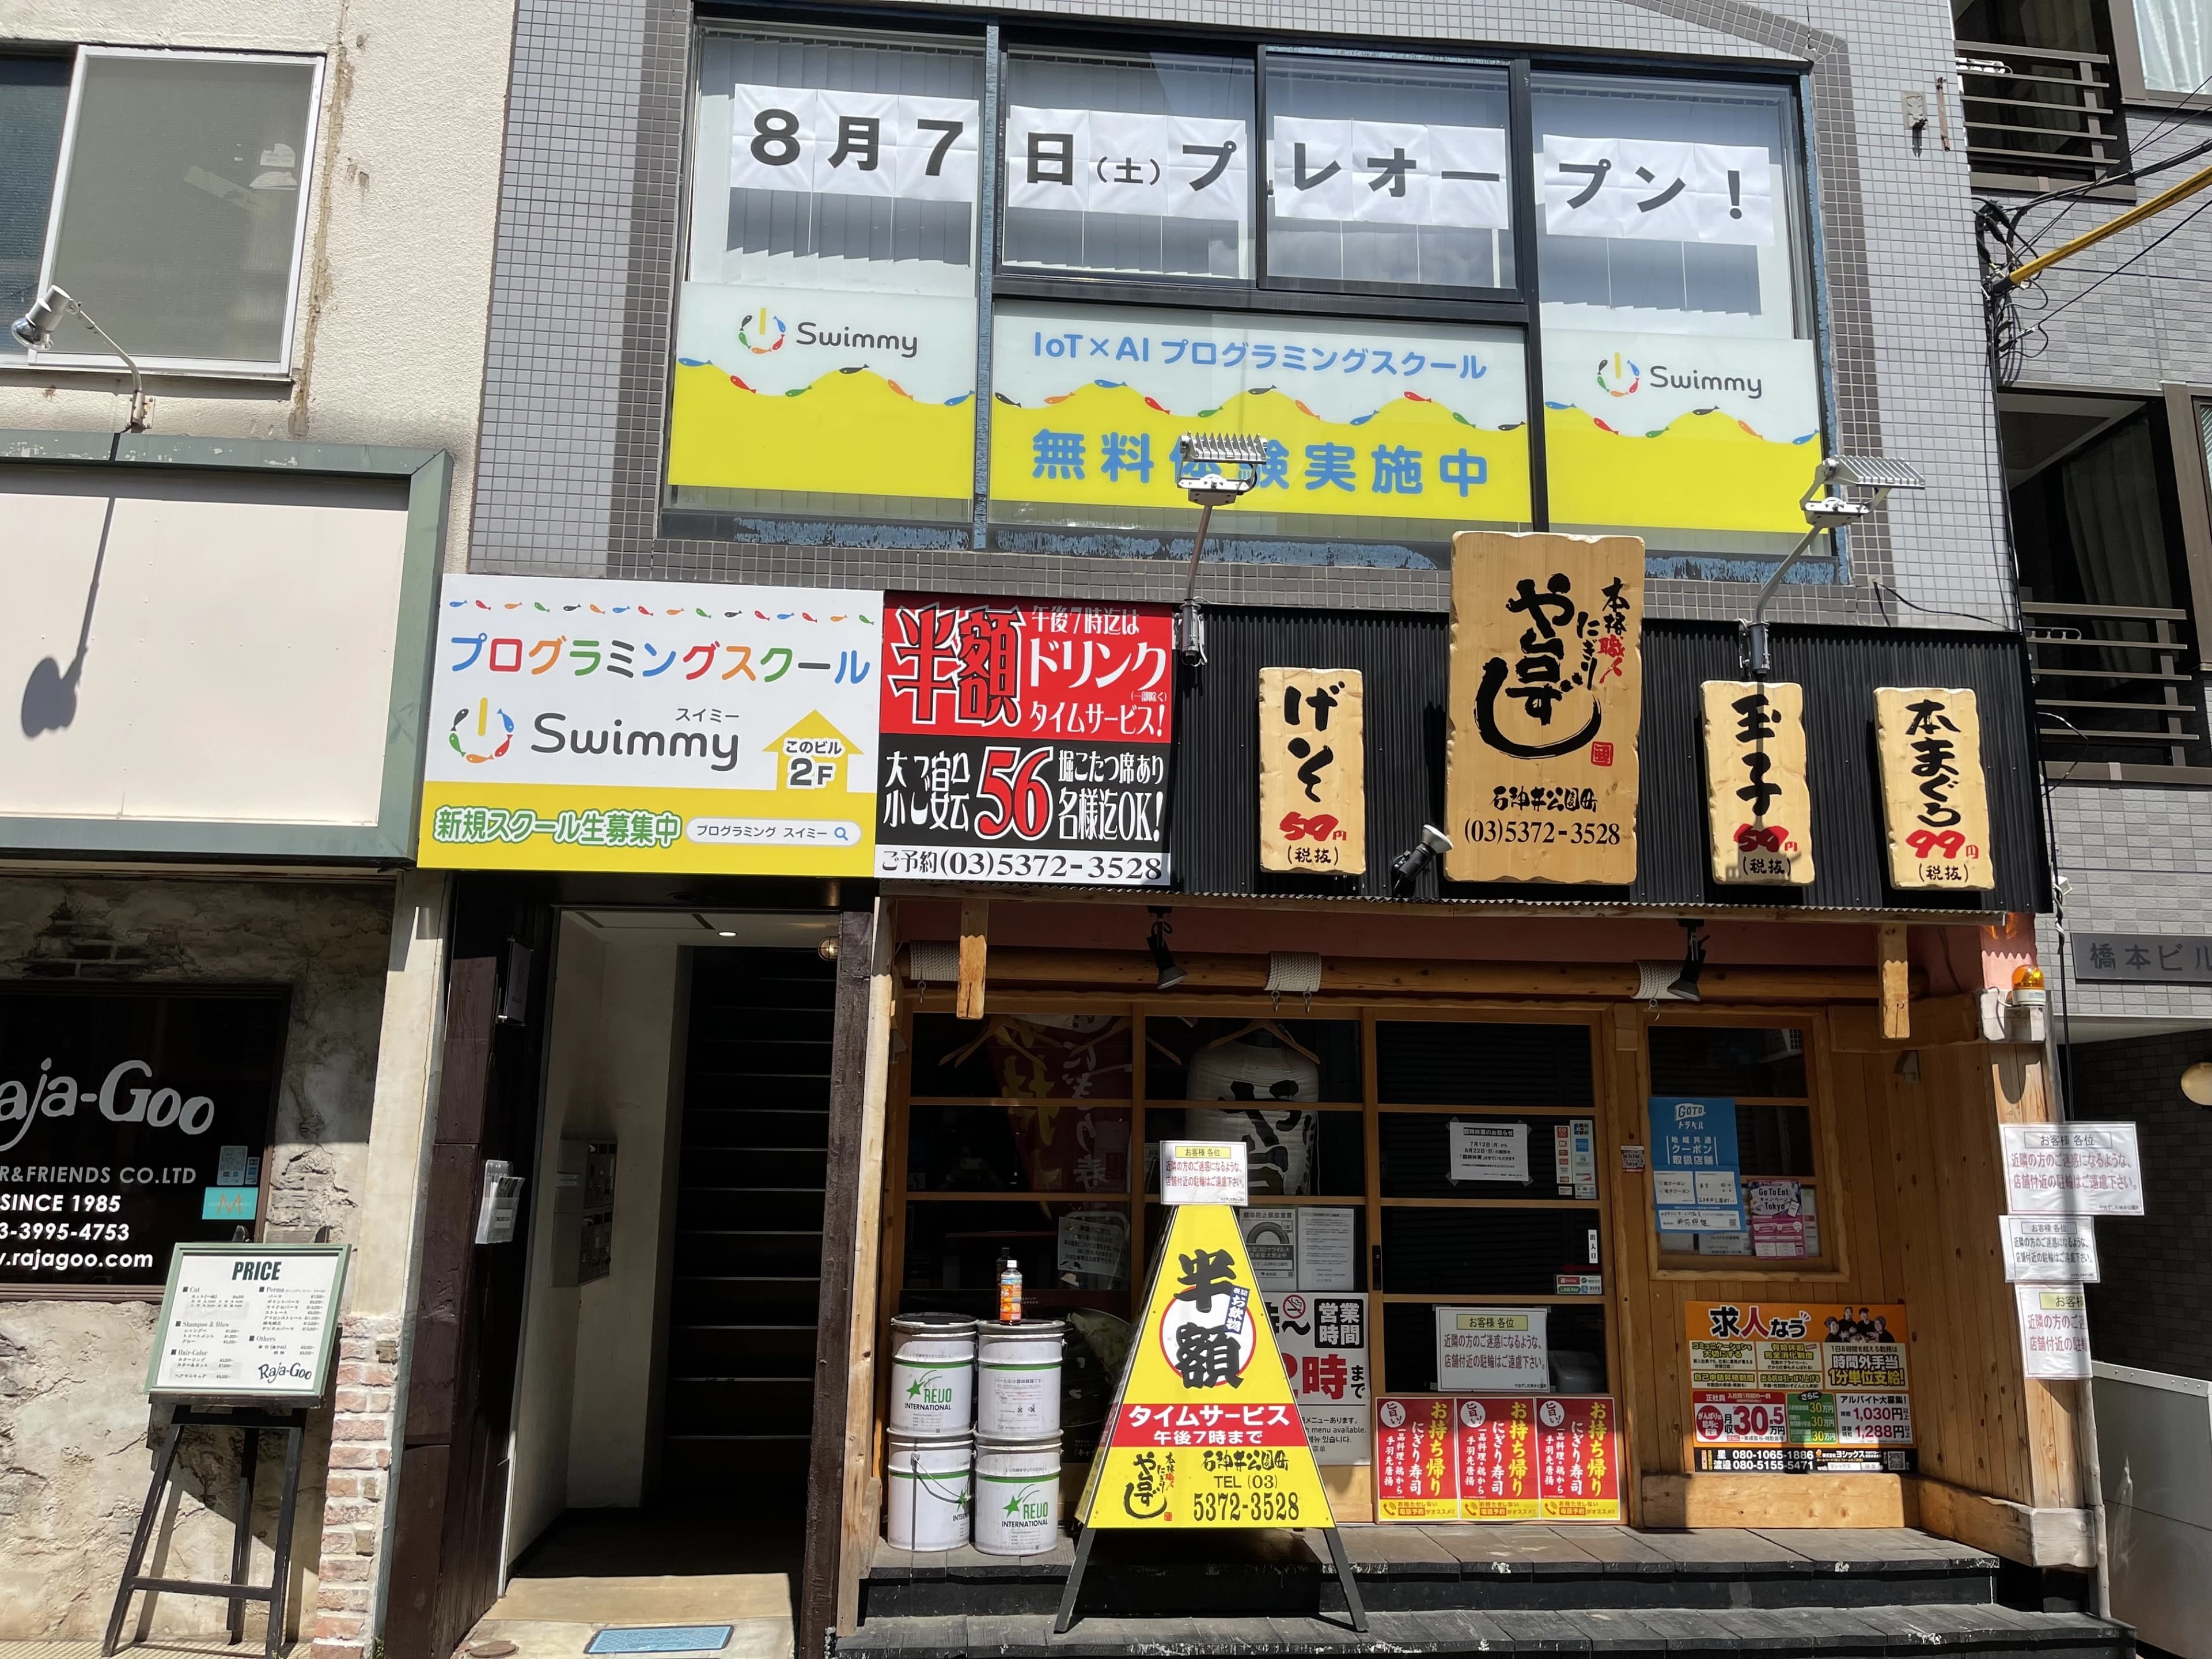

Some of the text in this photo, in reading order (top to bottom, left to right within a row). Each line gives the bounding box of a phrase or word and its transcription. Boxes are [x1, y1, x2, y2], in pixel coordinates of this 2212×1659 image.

[796, 321, 918, 358] Swimmy
[1162, 339, 1487, 379] プログラミングスクール
[1650, 368, 1762, 399] Swimmy
[1032, 606, 1139, 635] 午後7時迄は
[1597, 577, 1630, 684] 本格職人
[451, 632, 870, 684] プログラミングスクール
[888, 602, 1026, 727] 半額
[1031, 638, 1166, 691] ドリンク
[676, 708, 740, 723] スイミー
[1030, 702, 1164, 737] タイムサービス!
[531, 712, 739, 772] Swimmy
[785, 740, 842, 755] このビル
[1284, 681, 1346, 802] げそ
[1731, 695, 1782, 816] 玉子
[1905, 699, 1961, 827] 本まぐろ
[790, 758, 834, 786] 2F
[975, 746, 1054, 840] 56
[1058, 786, 1164, 842] 名様迄OK!
[435, 809, 681, 846] 新規スクール生募集中
[697, 825, 828, 839] プログラミング スイミー
[1464, 818, 1620, 845] (03)5372-3528
[1287, 846, 1339, 866] (税抜)
[1742, 858, 1791, 876] (税抜)
[1918, 863, 1969, 882] (税抜)
[1678, 1121, 1704, 1130] トラベル
[1671, 1145, 1713, 1154] クーポン
[2040, 1135, 2094, 1146] お客様 各位
[1185, 1147, 1221, 1157] お客様 各位
[1673, 1155, 1714, 1165] 取扱店舗
[2012, 1153, 2131, 1169] 近隣の方のご迷惑になるような、
[119, 1167, 196, 1184] CO.LTD
[2014, 1174, 2138, 1190] 店舗付近の駐輪はご遠慮下さい。
[1759, 1188, 1768, 1196] Go
[1777, 1188, 1789, 1196] Eat
[0, 1194, 122, 1213] SINCE 1985
[1765, 1202, 1785, 1211] Tokyo
[2031, 1224, 2067, 1232] お客様 各位
[2014, 1236, 2089, 1248] 近隣の方のご迷惑になるような、
[232, 1260, 282, 1281] PRICE
[1173, 1248, 1244, 1389] 半額
[1319, 1302, 1360, 1324] 営業
[1469, 1317, 1514, 1328] お客様 各位
[1709, 1305, 1808, 1339] 求人なう
[1319, 1325, 1360, 1346] 時間
[1444, 1334, 1541, 1349] 近隣の方のご迷惑になるような、
[1444, 1353, 1545, 1370] 店舗付近の駐輪はご遠慮下さい。
[1703, 1350, 1743, 1358] 大切にする
[1832, 1354, 1900, 1369] 時間外手当
[258, 1362, 312, 1384] Raja-Goo
[1828, 1369, 1905, 1385] 1分単位支給!
[1801, 1391, 1820, 1400] さらに
[1840, 1396, 1907, 1404] アルバイト大募集!
[904, 1402, 952, 1411] INTERNATIONAL
[1128, 1406, 1290, 1427] タイムサービス
[1810, 1402, 1834, 1414] 30万円
[1810, 1416, 1835, 1427] 30万円
[1153, 1430, 1263, 1445] 午後7時まで
[1812, 1430, 1836, 1441] 30万円
[1408, 1421, 1425, 1496] にぎり寿司
[1426, 1402, 1448, 1497] お持ち帰り
[1491, 1421, 1506, 1496] にぎり寿司
[1508, 1402, 1529, 1497] お持ち帰り
[1570, 1421, 1584, 1495] にぎり寿司
[1586, 1402, 1608, 1497] お持ち帰り
[1732, 1449, 1814, 1460] 080-1065-1886
[1384, 1436, 1395, 1486] 手羽先唐揚
[1465, 1436, 1476, 1486] 手羽先唐揚
[1544, 1435, 1555, 1486] 手羽先唐揚
[1733, 1460, 1813, 1471] 080-5155-5471
[1214, 1475, 1278, 1489] TEL (03)
[1193, 1491, 1300, 1521] 5372-3528
[1001, 1519, 1048, 1527] INTERNATIONAL
